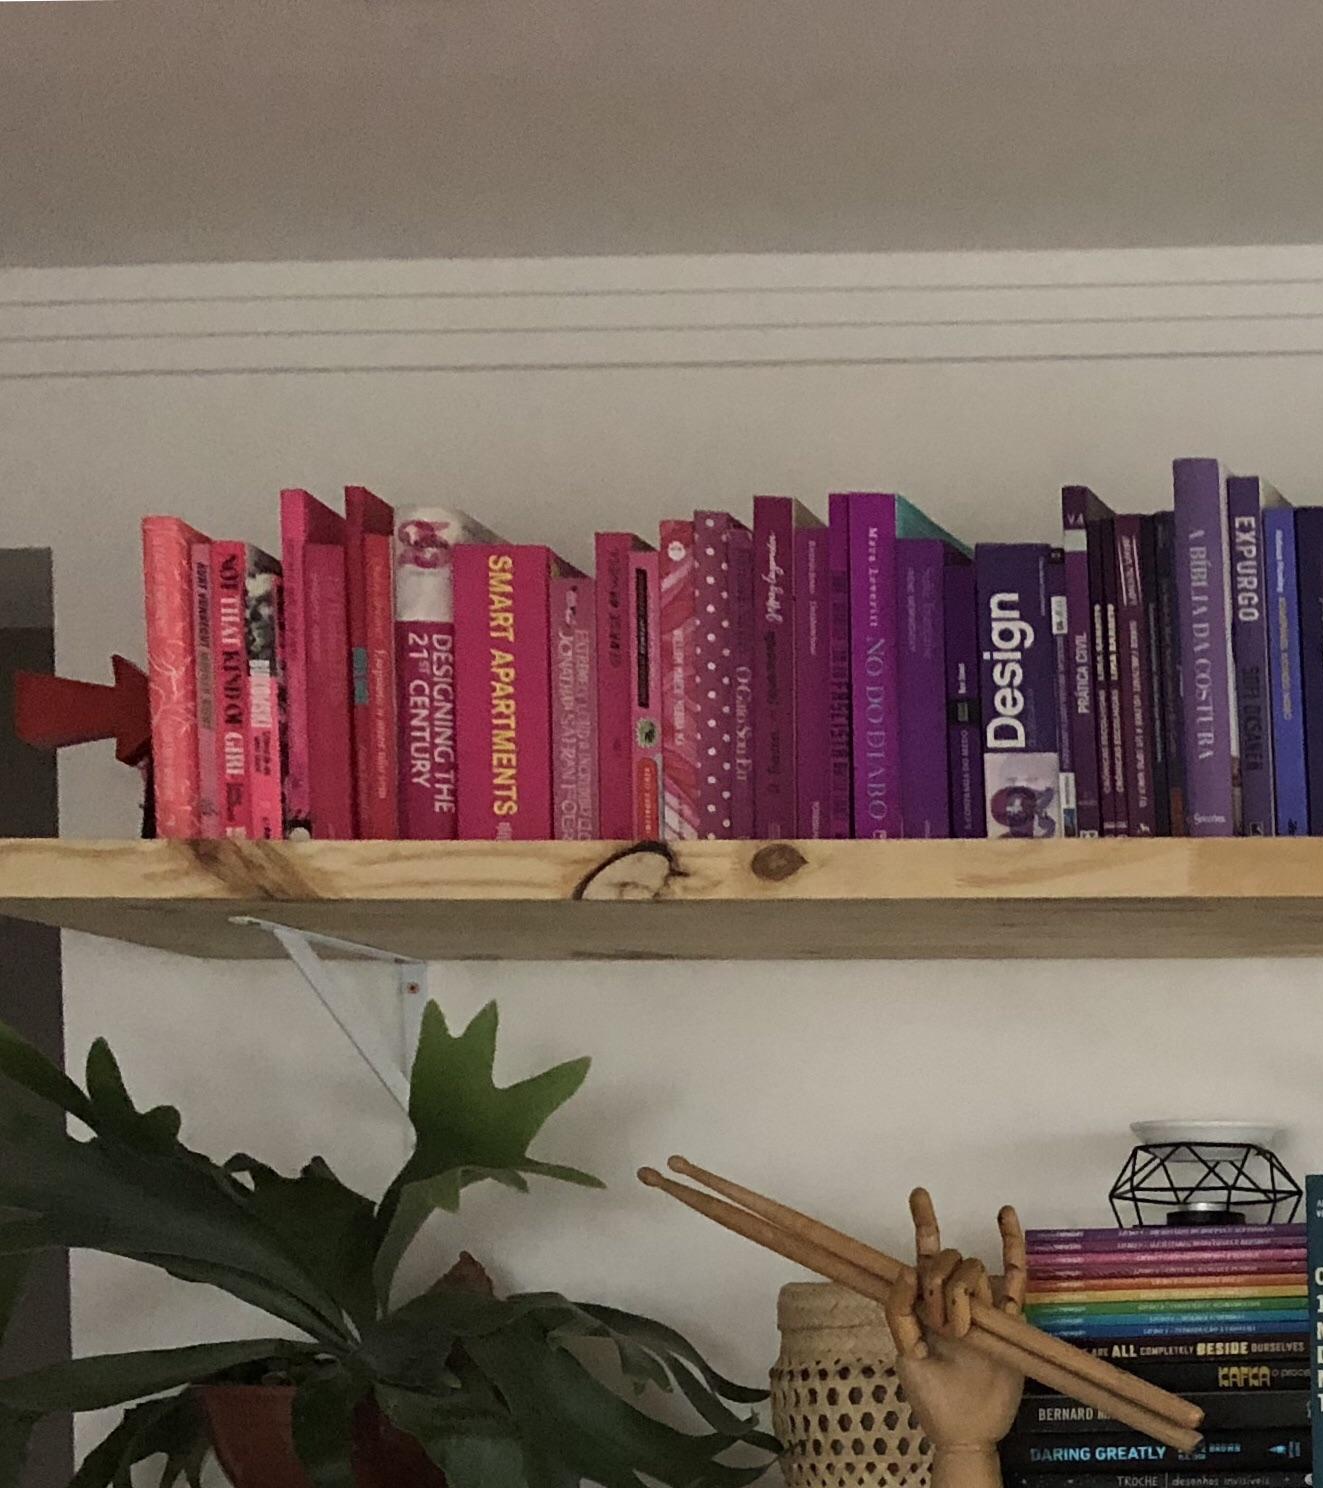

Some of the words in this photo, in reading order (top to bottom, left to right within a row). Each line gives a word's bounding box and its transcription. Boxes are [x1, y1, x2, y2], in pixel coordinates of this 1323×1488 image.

[487, 555, 514, 643] SMART
[1189, 546, 1211, 617] BÍBLIA
[1233, 516, 1259, 624] EXPURGO
[220, 596, 241, 648] THAT
[1191, 623, 1211, 653] DA
[431, 633, 454, 764] DESIGNING
[983, 593, 1034, 748] Design
[409, 679, 431, 788] CENTURY
[489, 649, 518, 816] APARTMENTS
[865, 686, 887, 725] DO
[1194, 658, 1215, 761] COSTURA
[224, 732, 245, 779] GIRL
[863, 731, 888, 821] DIABO
[433, 772, 455, 814] THE
[1111, 1344, 1137, 1358] ALL
[1196, 1342, 1249, 1356] BESIDE
[1218, 1366, 1271, 1387] KAFKA
[1038, 1408, 1094, 1421] BERNARD
[1030, 1447, 1090, 1462] DARING
[1095, 1446, 1167, 1461] GREATLY
